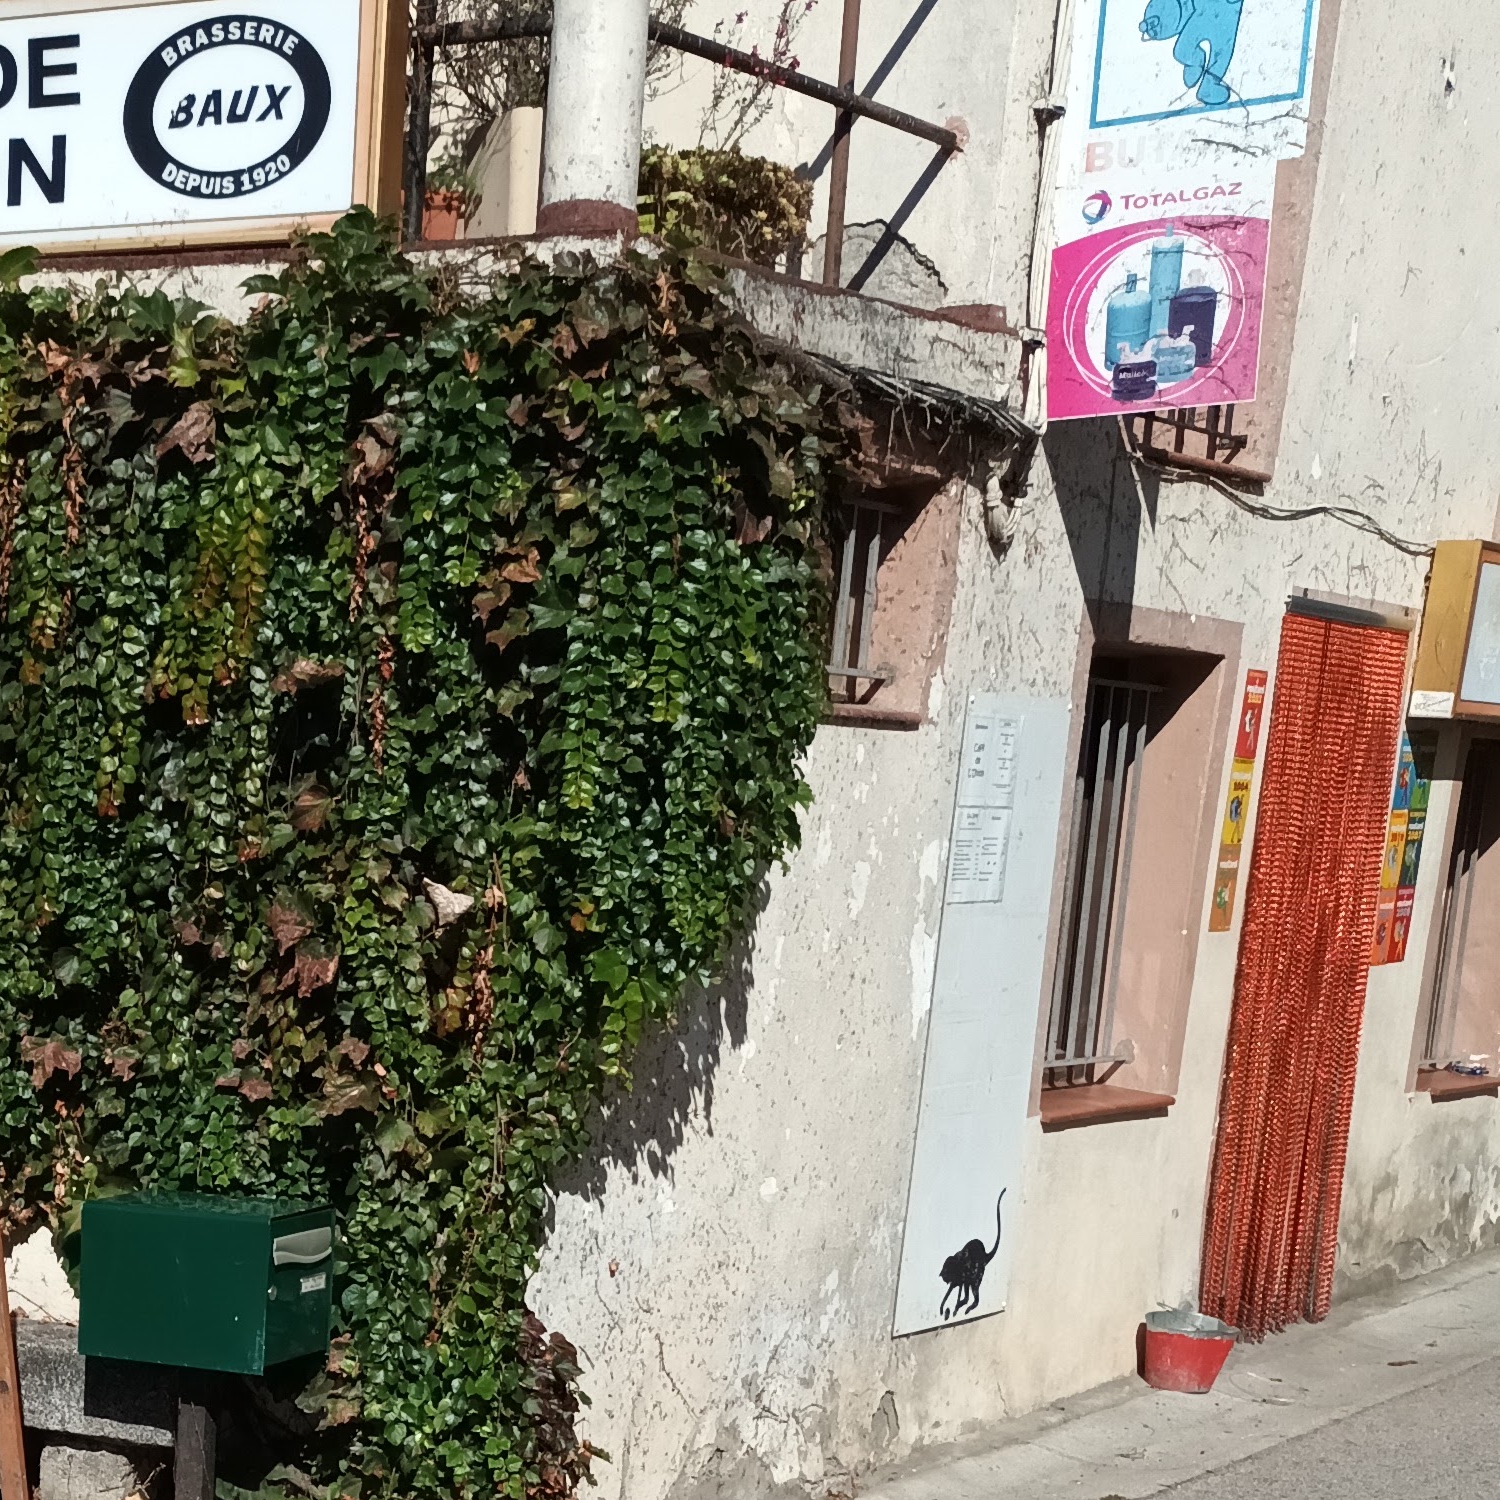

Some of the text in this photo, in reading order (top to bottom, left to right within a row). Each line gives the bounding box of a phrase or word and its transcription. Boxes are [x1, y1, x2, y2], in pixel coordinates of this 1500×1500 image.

[161, 21, 299, 67] BRASSERIE
[168, 84, 292, 130] BAUX
[161, 154, 291, 195] DEPUIS 1920
[1120, 181, 1243, 210] TOTALGAZ
